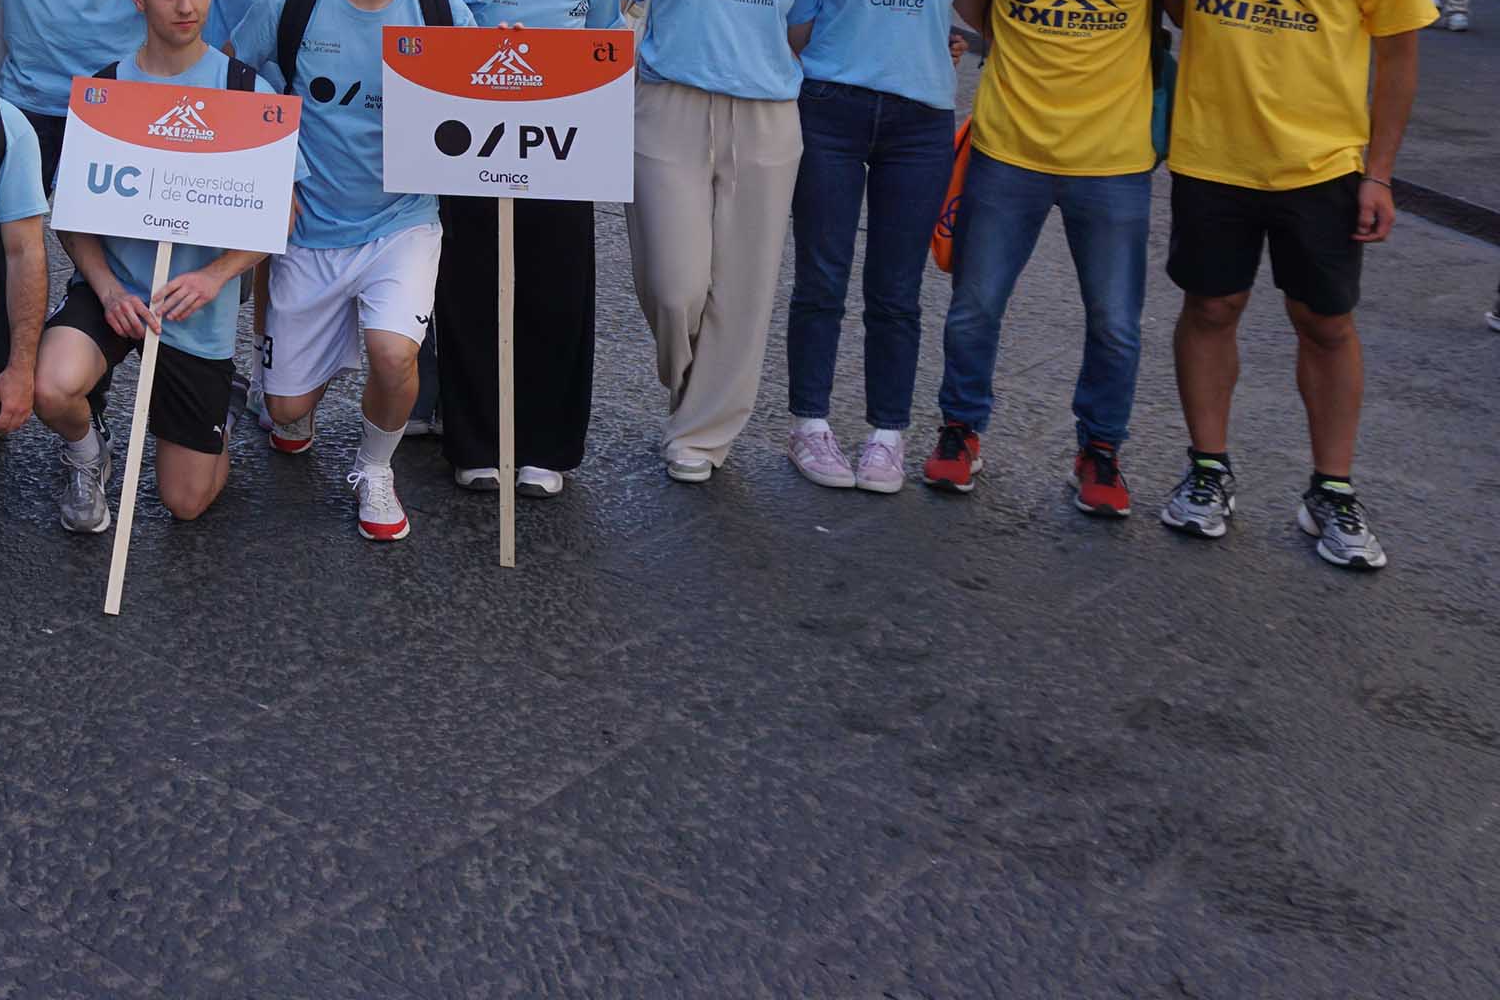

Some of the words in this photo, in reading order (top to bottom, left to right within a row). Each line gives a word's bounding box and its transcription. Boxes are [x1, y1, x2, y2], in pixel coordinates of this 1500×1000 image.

[1008, 0, 1064, 28] XXI
[1067, 11, 1128, 23] PALIO
[1252, 4, 1319, 25] PALIO
[470, 74, 506, 86] XXI
[507, 75, 544, 83] PALIO
[148, 125, 180, 137] XXI
[181, 128, 214, 137] PALIO
[519, 125, 578, 160] PV
[87, 162, 142, 197] UC
[163, 167, 255, 193] Universidad
[478, 169, 529, 184] Eunice
[160, 188, 182, 201] de
[185, 189, 264, 210] Cantabria
[143, 213, 190, 230] Eunice
